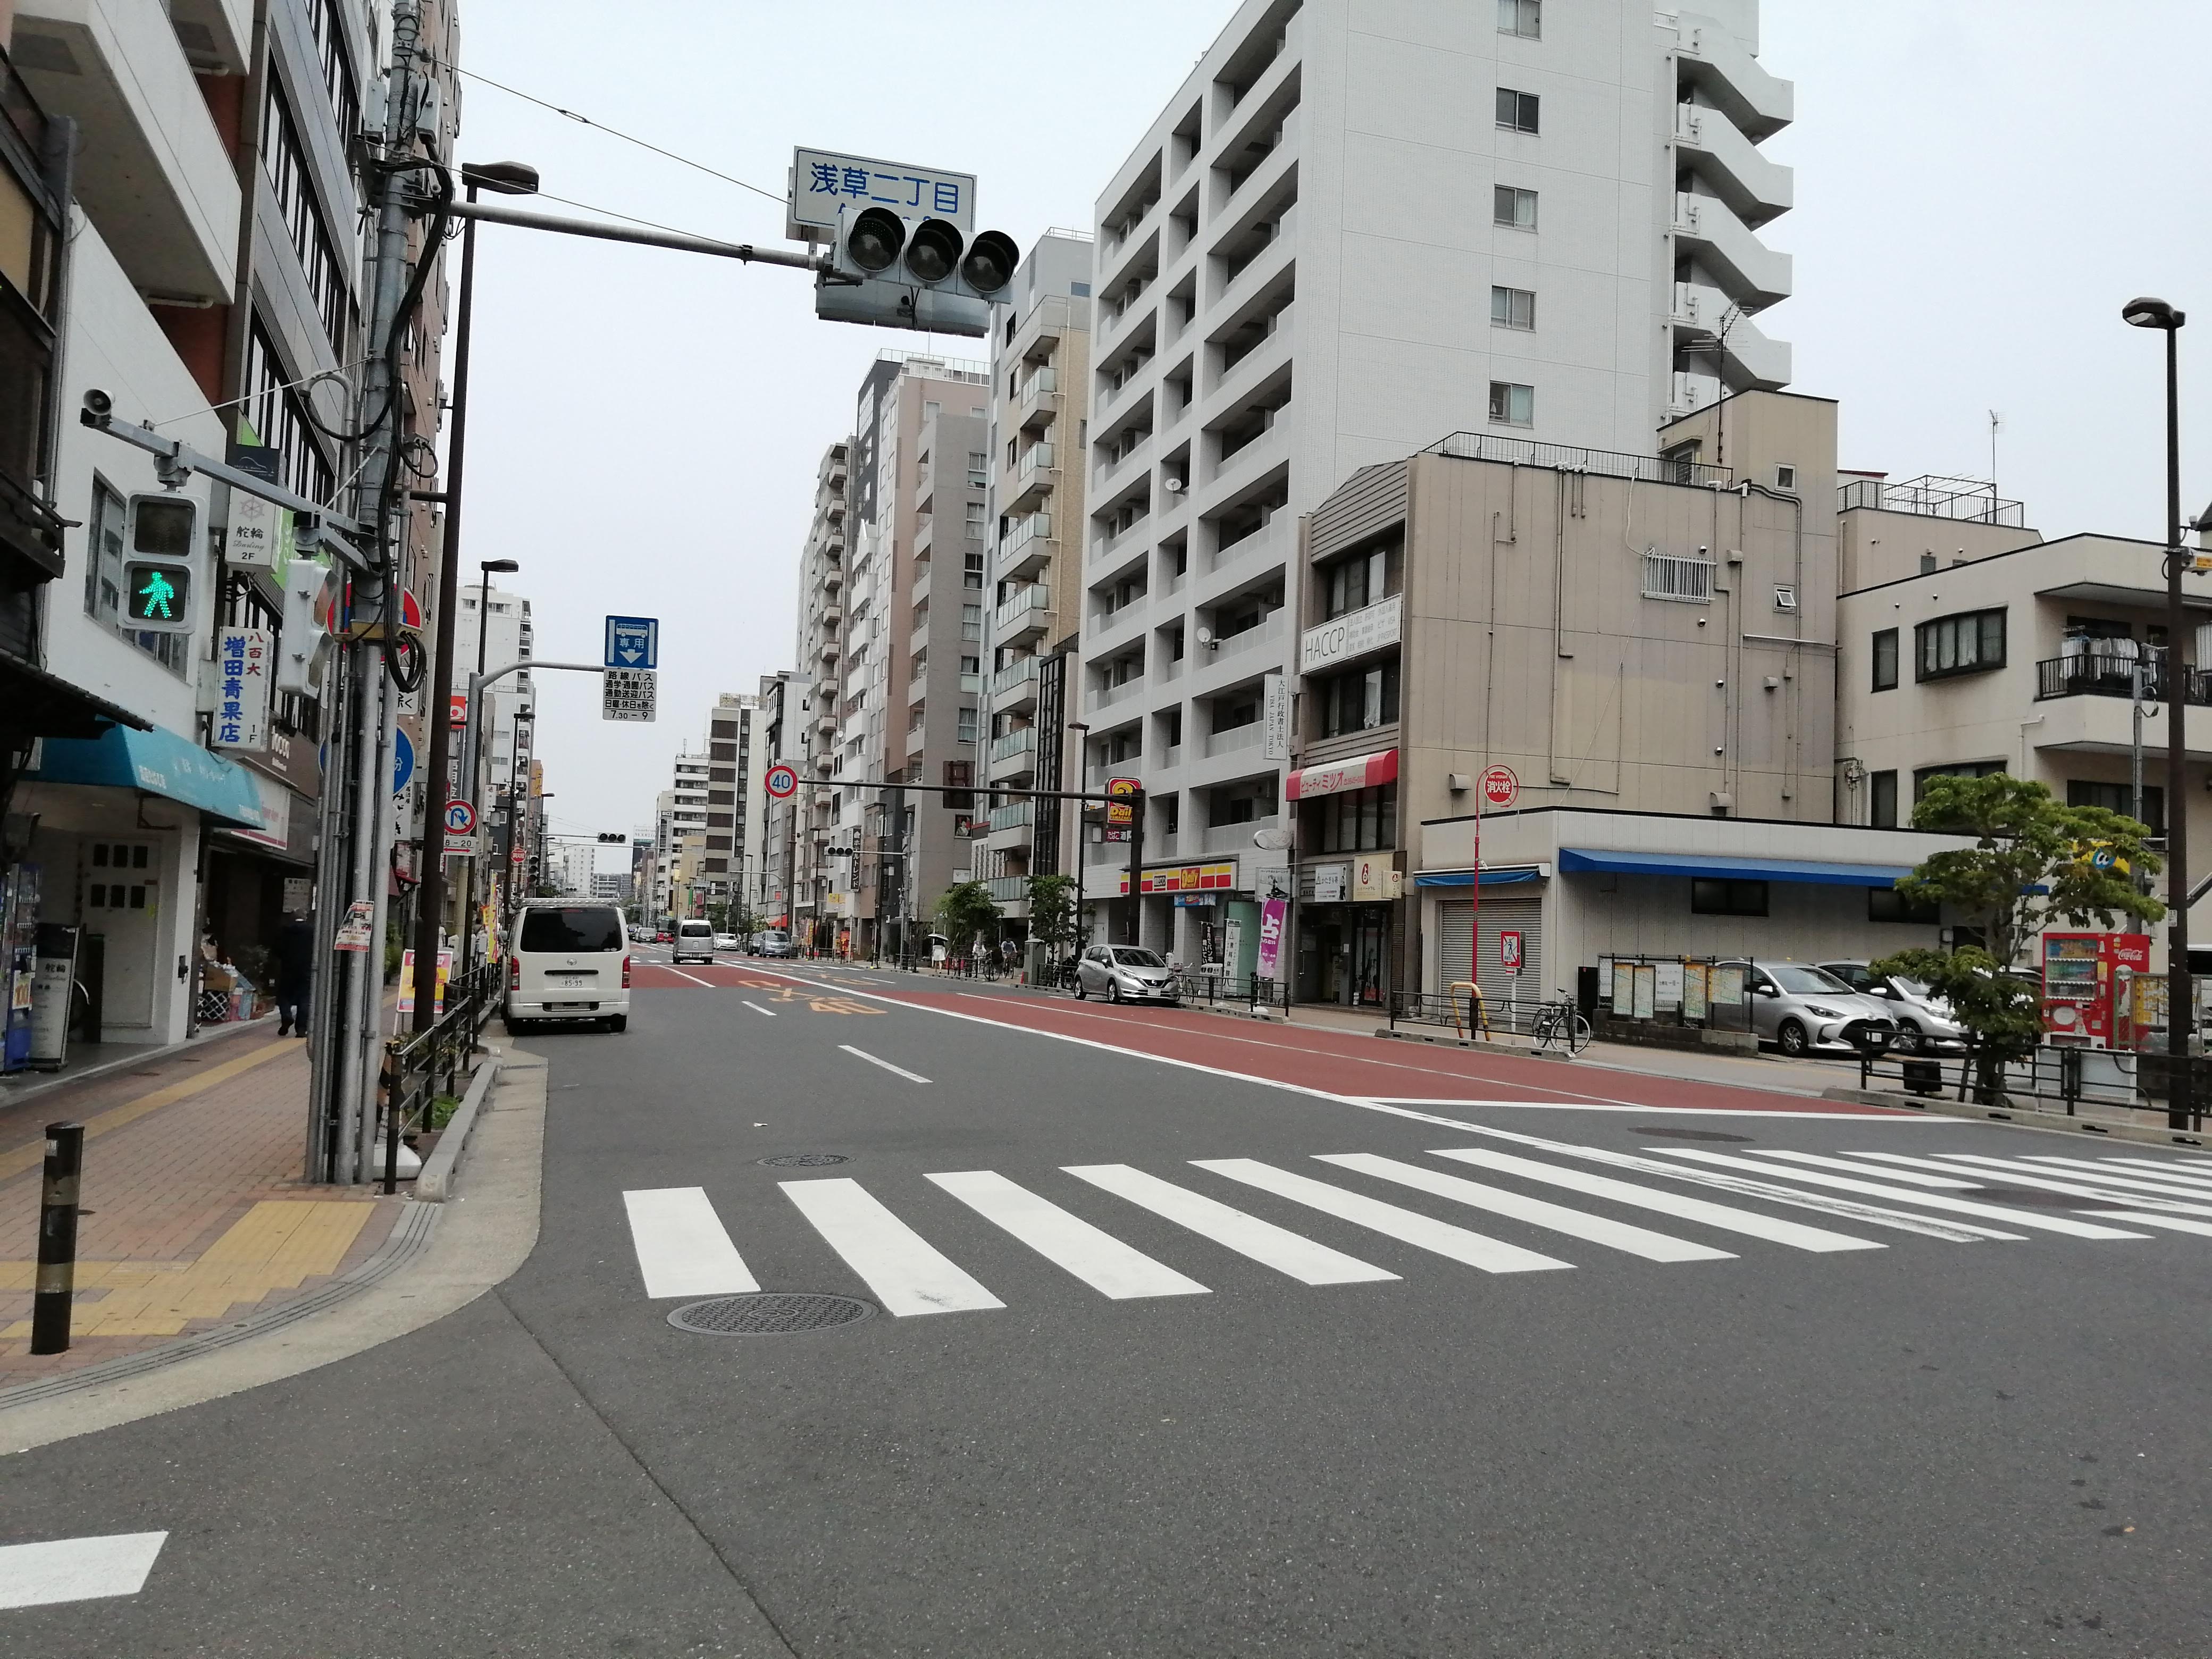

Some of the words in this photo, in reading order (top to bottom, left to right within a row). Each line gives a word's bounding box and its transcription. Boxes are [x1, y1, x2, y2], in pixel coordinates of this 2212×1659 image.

[809, 162, 959, 214] 浅草二丁目
[236, 525, 264, 540] 舵輪
[619, 638, 644, 649] 専用
[1305, 626, 1345, 663] HACCP
[246, 632, 264, 676] 八百大
[608, 671, 652, 681] 路線バス
[219, 635, 246, 743] 増田青果店
[1277, 679, 1285, 748] 大江戸行政書士法人
[772, 774, 791, 789] 40
[1322, 770, 1344, 792] ミツオ
[1487, 781, 1511, 793] 消火栓
[1181, 868, 1199, 887] Daily
[1261, 914, 1280, 940] 占
[2118, 949, 2143, 961] Coca-Cola
[809, 1001, 889, 1015] 40
